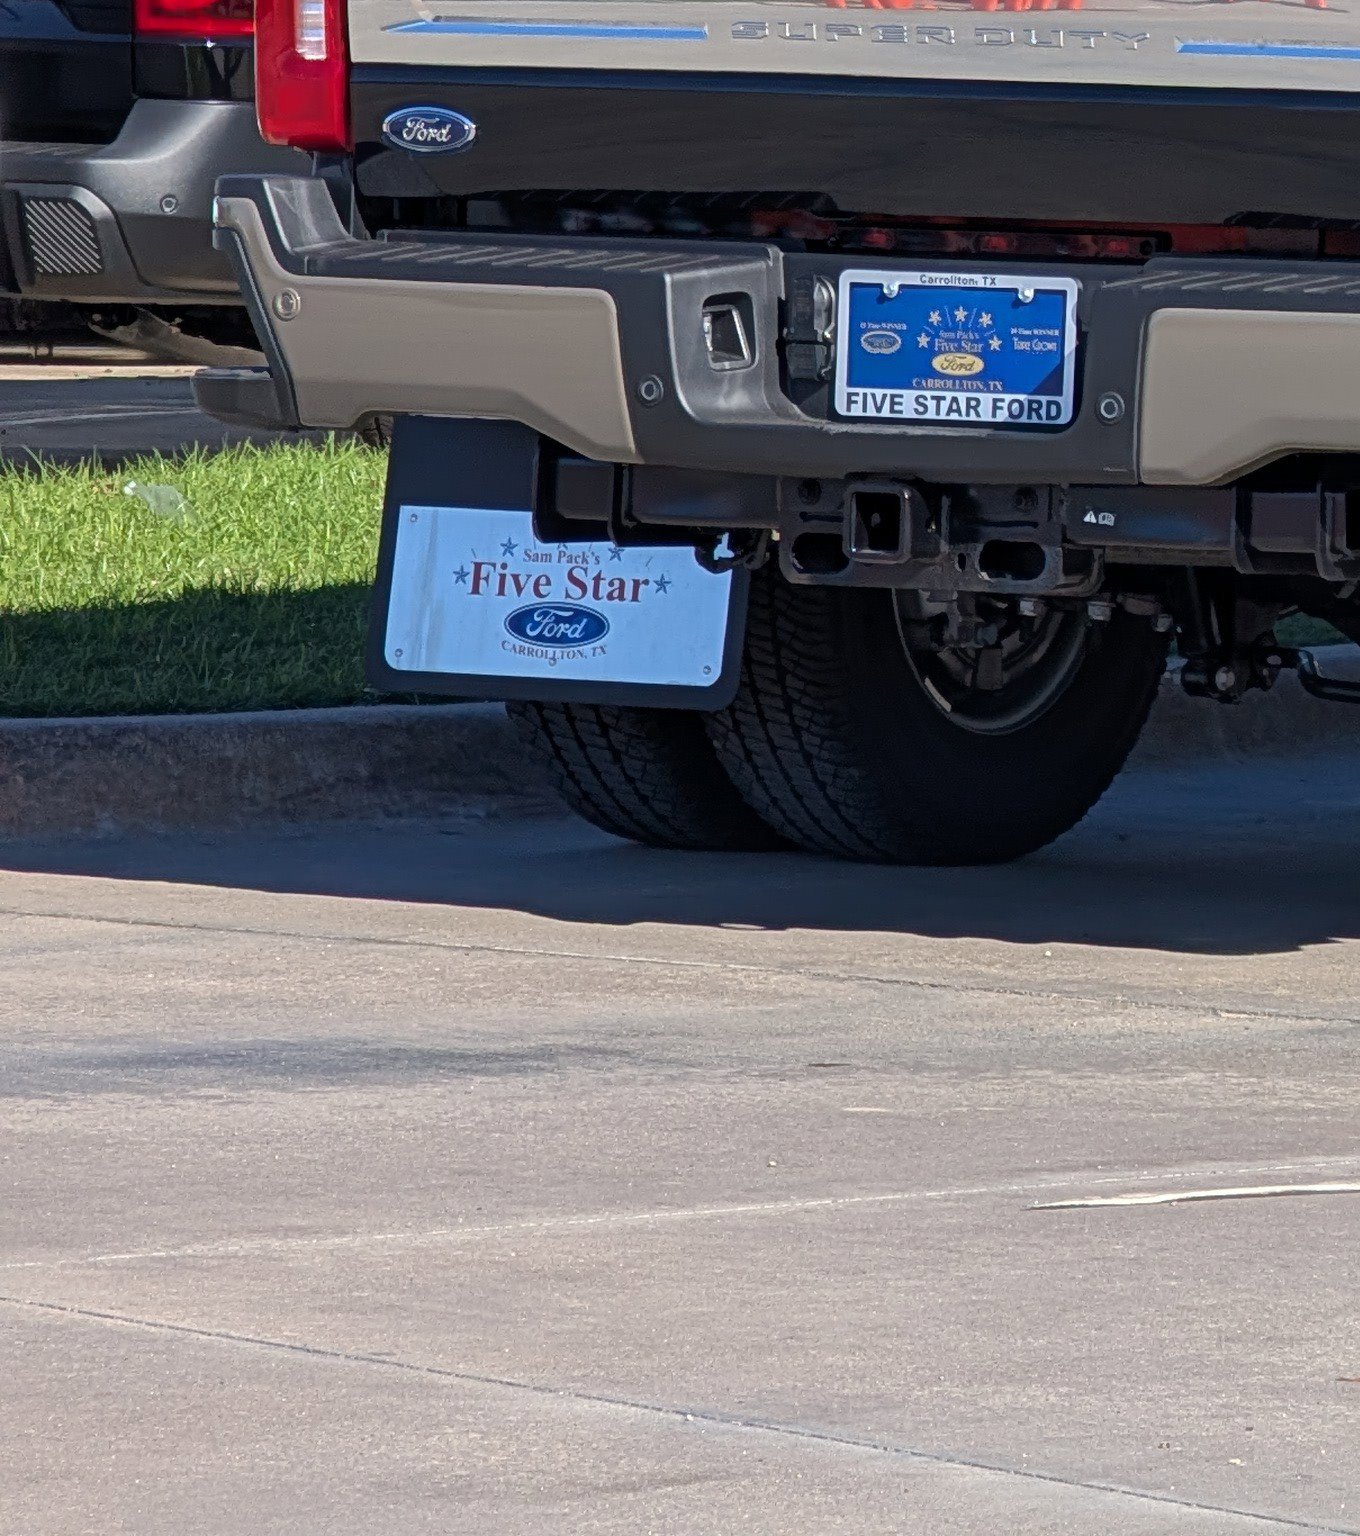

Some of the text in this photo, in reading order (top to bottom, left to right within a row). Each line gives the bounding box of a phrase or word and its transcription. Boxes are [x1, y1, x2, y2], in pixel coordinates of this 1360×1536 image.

[731, 20, 1150, 51] SUPER DUTY
[402, 116, 452, 142] Ford
[982, 276, 997, 286] TX
[934, 338, 984, 353] Five Star
[940, 355, 976, 371] Ford
[846, 391, 1062, 421] FIVE STAR FORD
[522, 548, 601, 567] Sam Pack's
[468, 560, 651, 603] Five Star
[525, 608, 587, 639] Ford
[591, 644, 609, 658] TX
